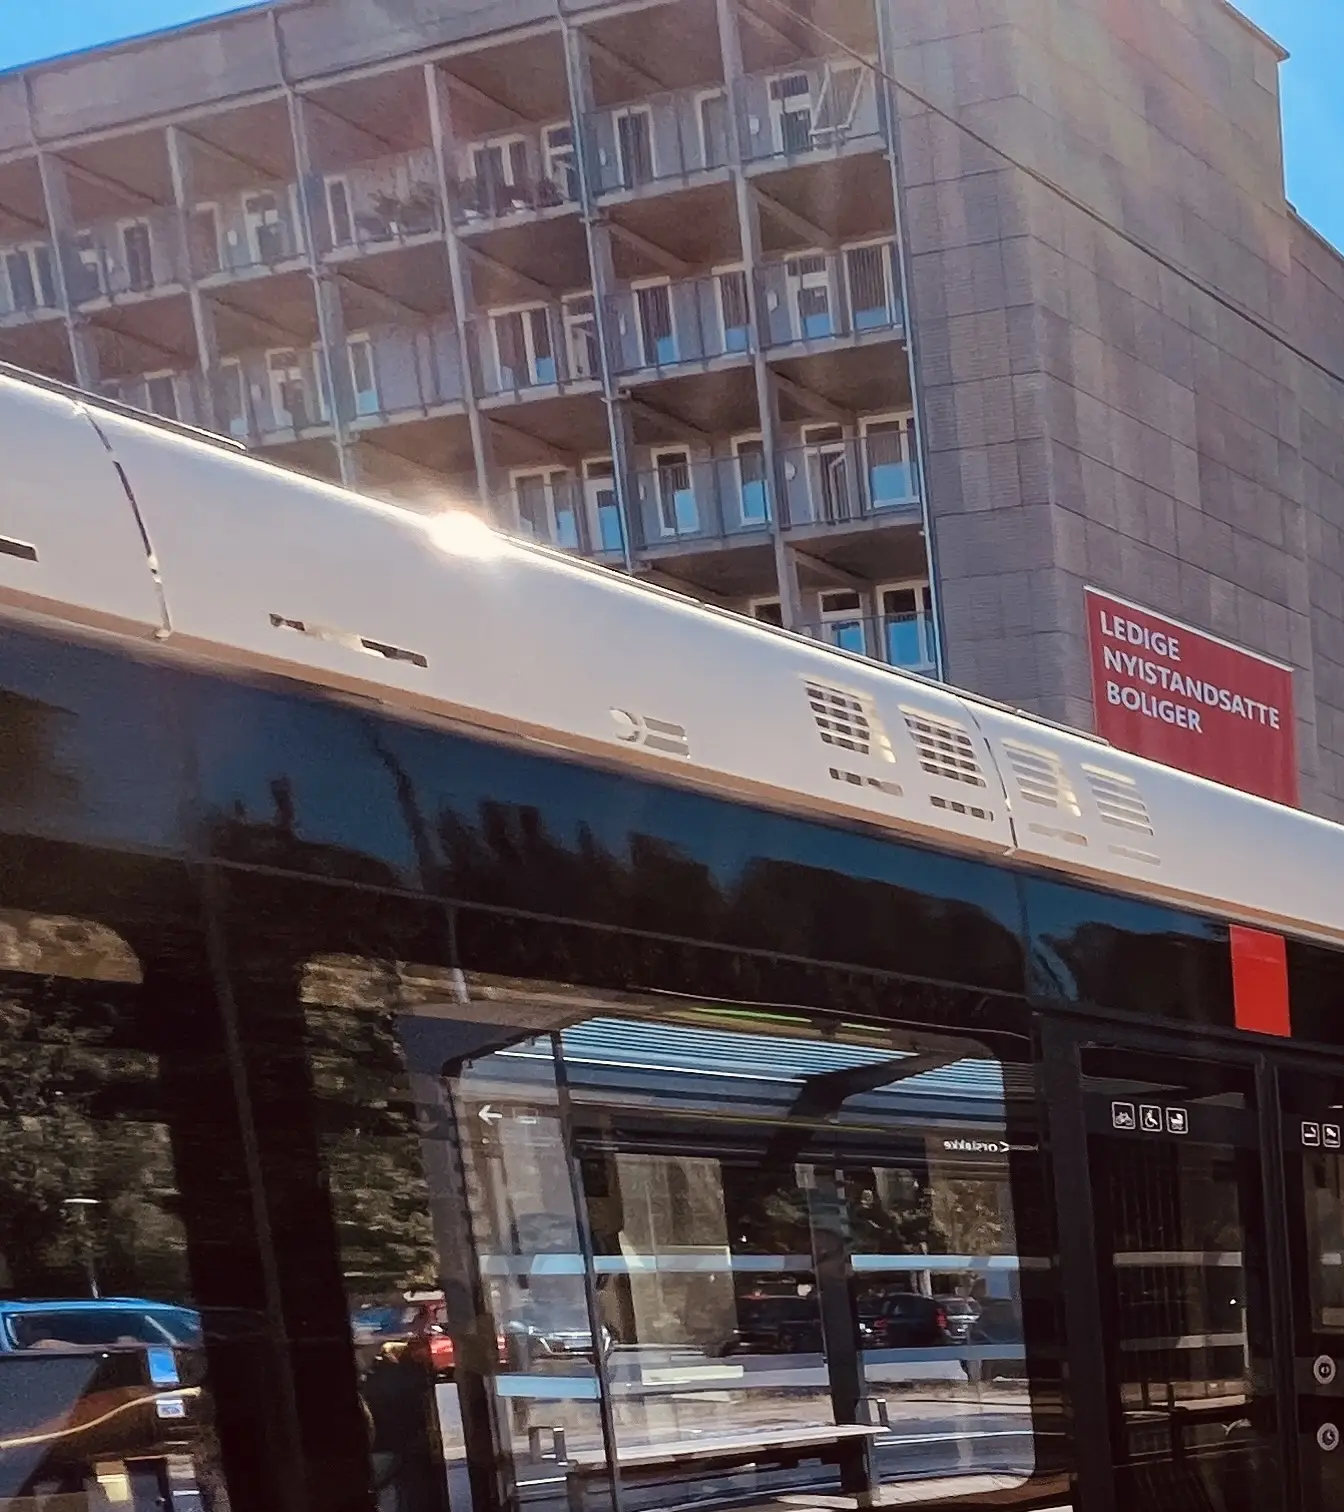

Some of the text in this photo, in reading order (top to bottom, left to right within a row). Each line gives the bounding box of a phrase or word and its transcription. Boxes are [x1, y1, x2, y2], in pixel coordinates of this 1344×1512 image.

[1099, 610, 1182, 662] LEDIGE
[1103, 646, 1281, 730] NYISTANDSATTE
[1106, 680, 1204, 734] BOLIGER
